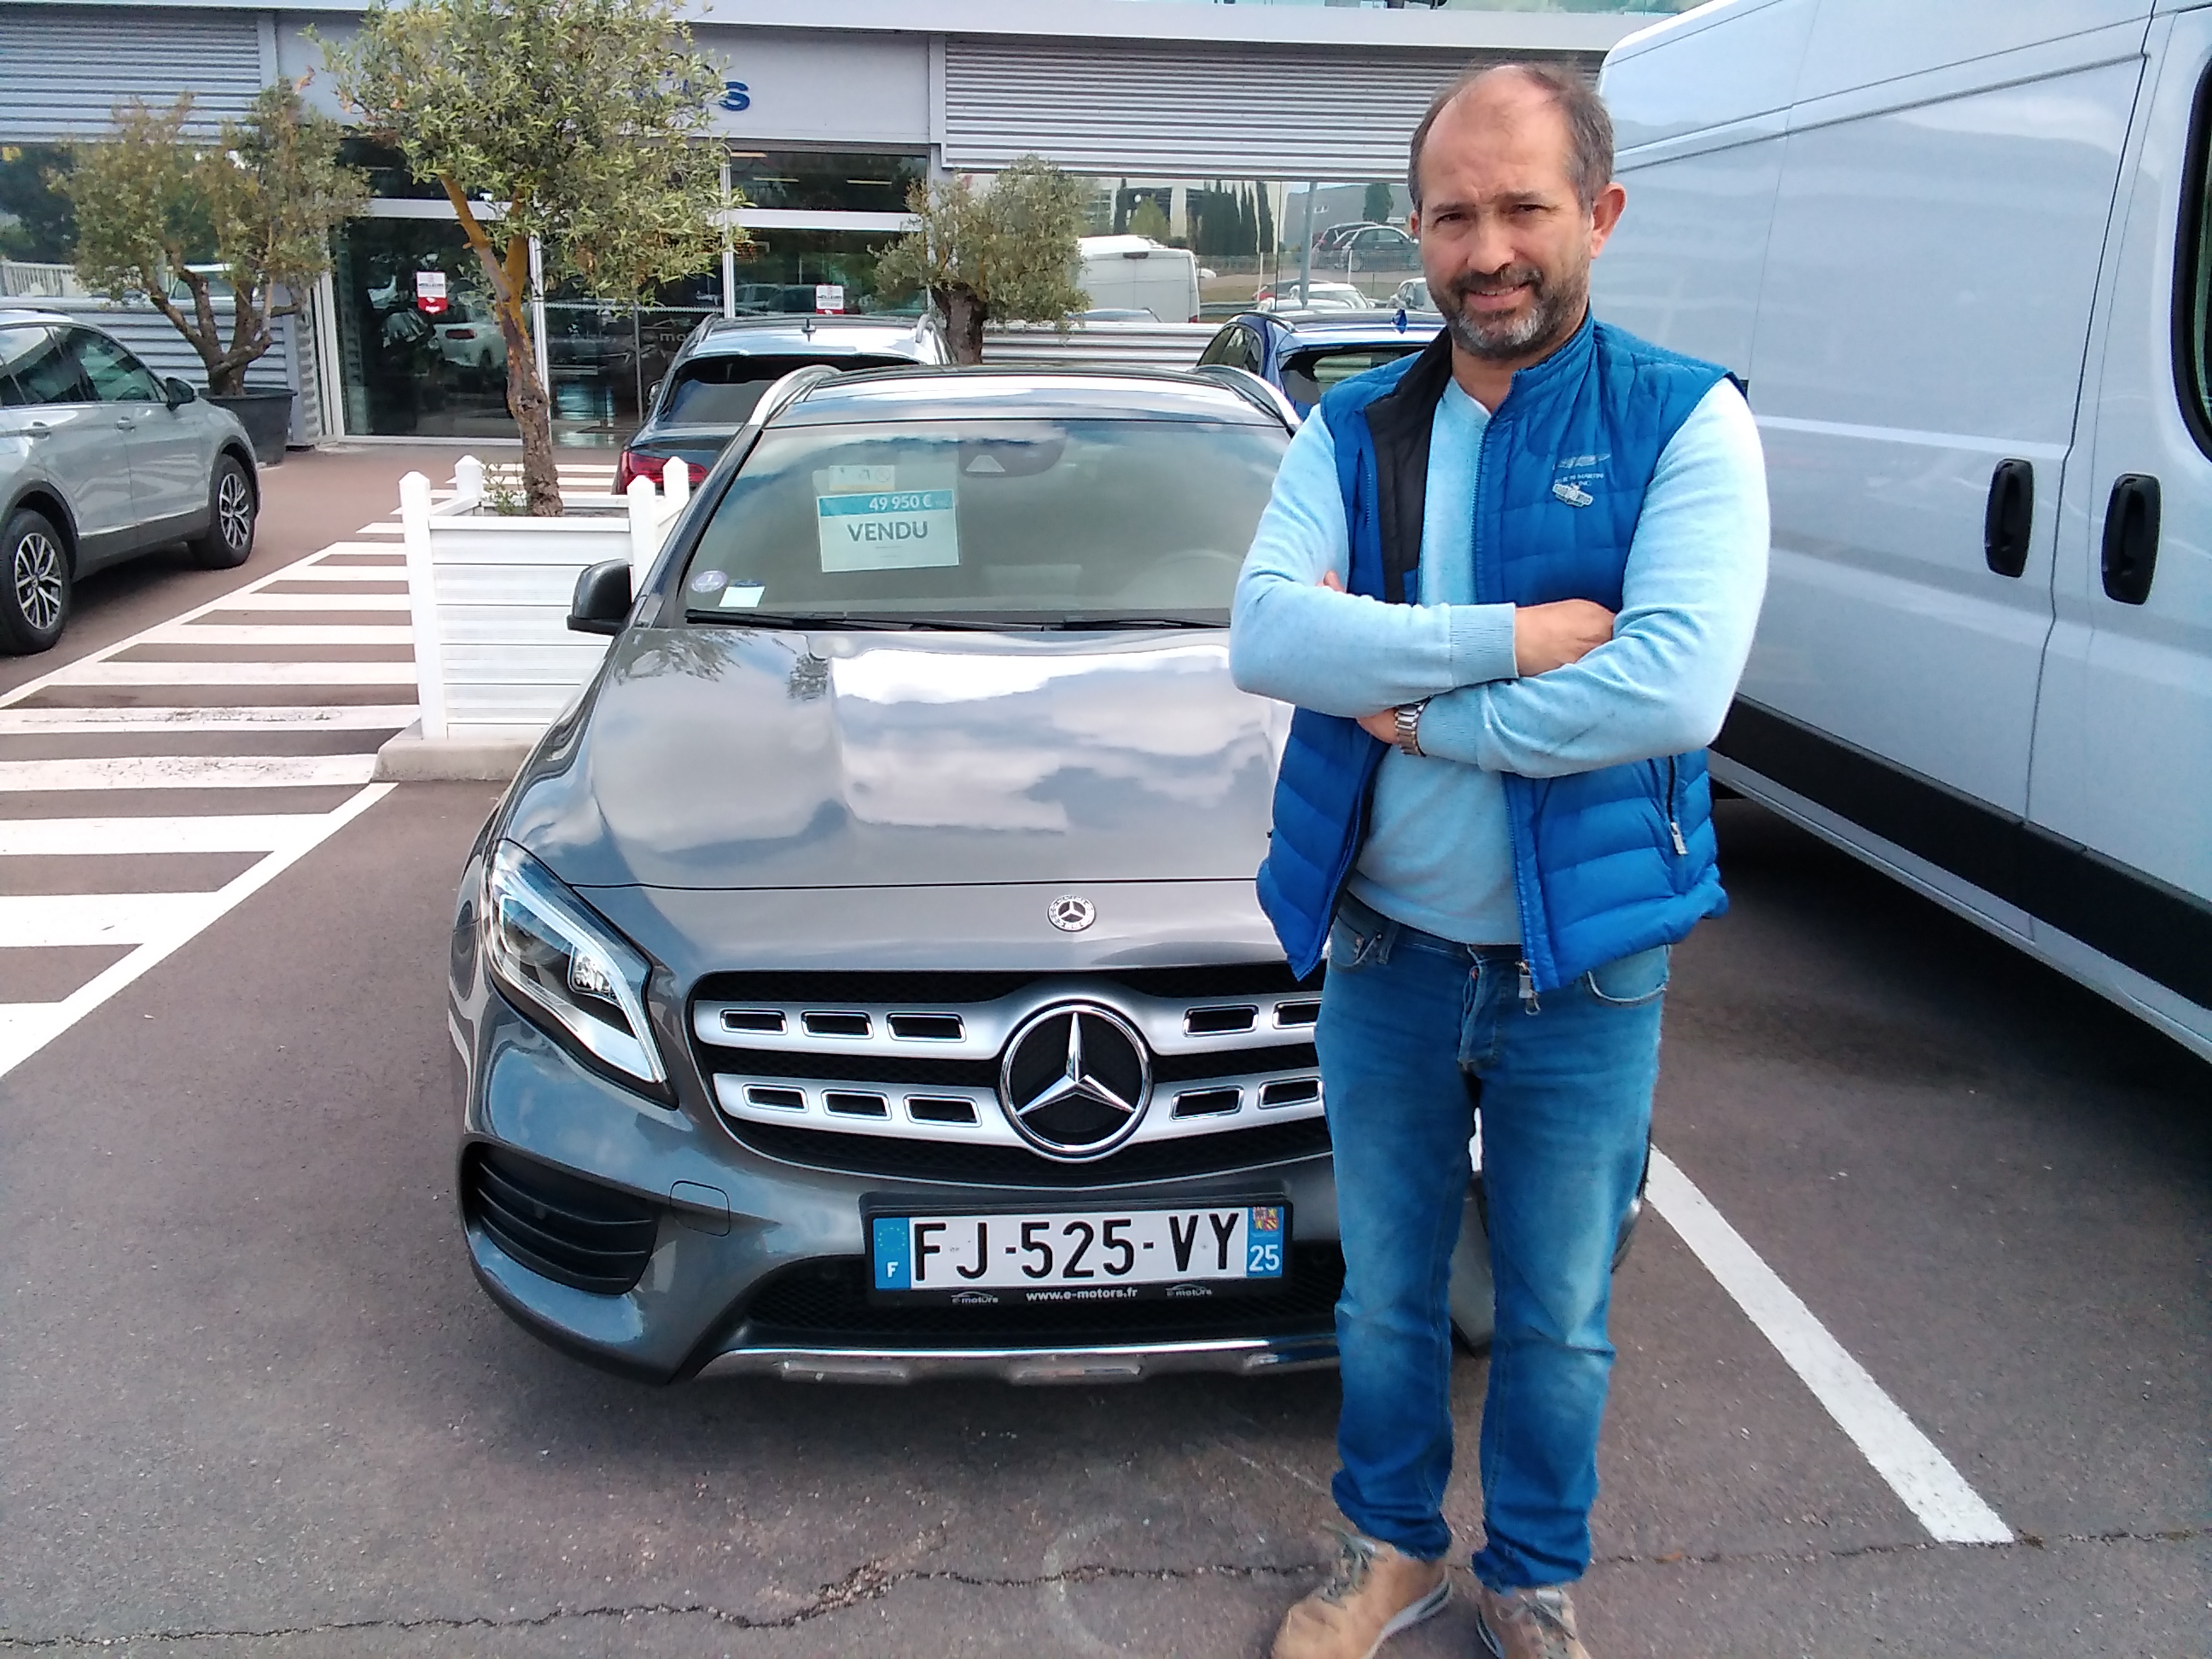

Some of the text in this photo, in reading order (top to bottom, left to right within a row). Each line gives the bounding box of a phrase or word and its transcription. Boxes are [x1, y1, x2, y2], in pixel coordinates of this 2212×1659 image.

[869, 498, 888, 511] 49
[891, 495, 920, 509] 950
[847, 521, 928, 542] VENDU
[914, 1213, 1239, 1281] FJ-525-VY
[1249, 1243, 1280, 1272] 25
[887, 1261, 899, 1278] F
[1026, 1286, 1138, 1301] www.e-motors.fr
